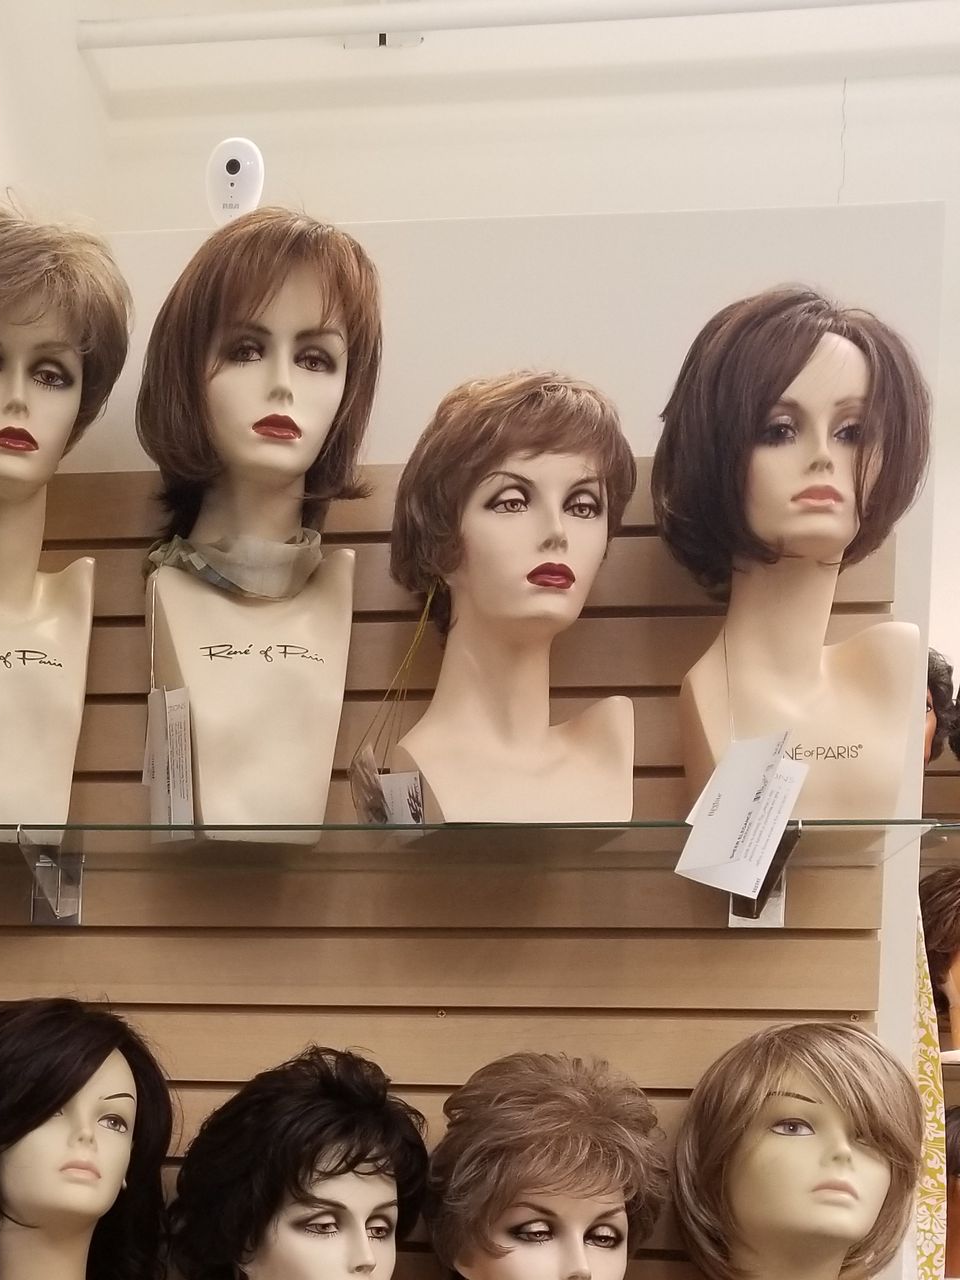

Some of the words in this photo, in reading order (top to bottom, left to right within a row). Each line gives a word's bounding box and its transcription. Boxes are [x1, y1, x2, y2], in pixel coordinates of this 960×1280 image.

[0, 651, 12, 669] of
[14, 649, 63, 668] Paris
[259, 645, 274, 662] of
[276, 644, 325, 664] Paris
